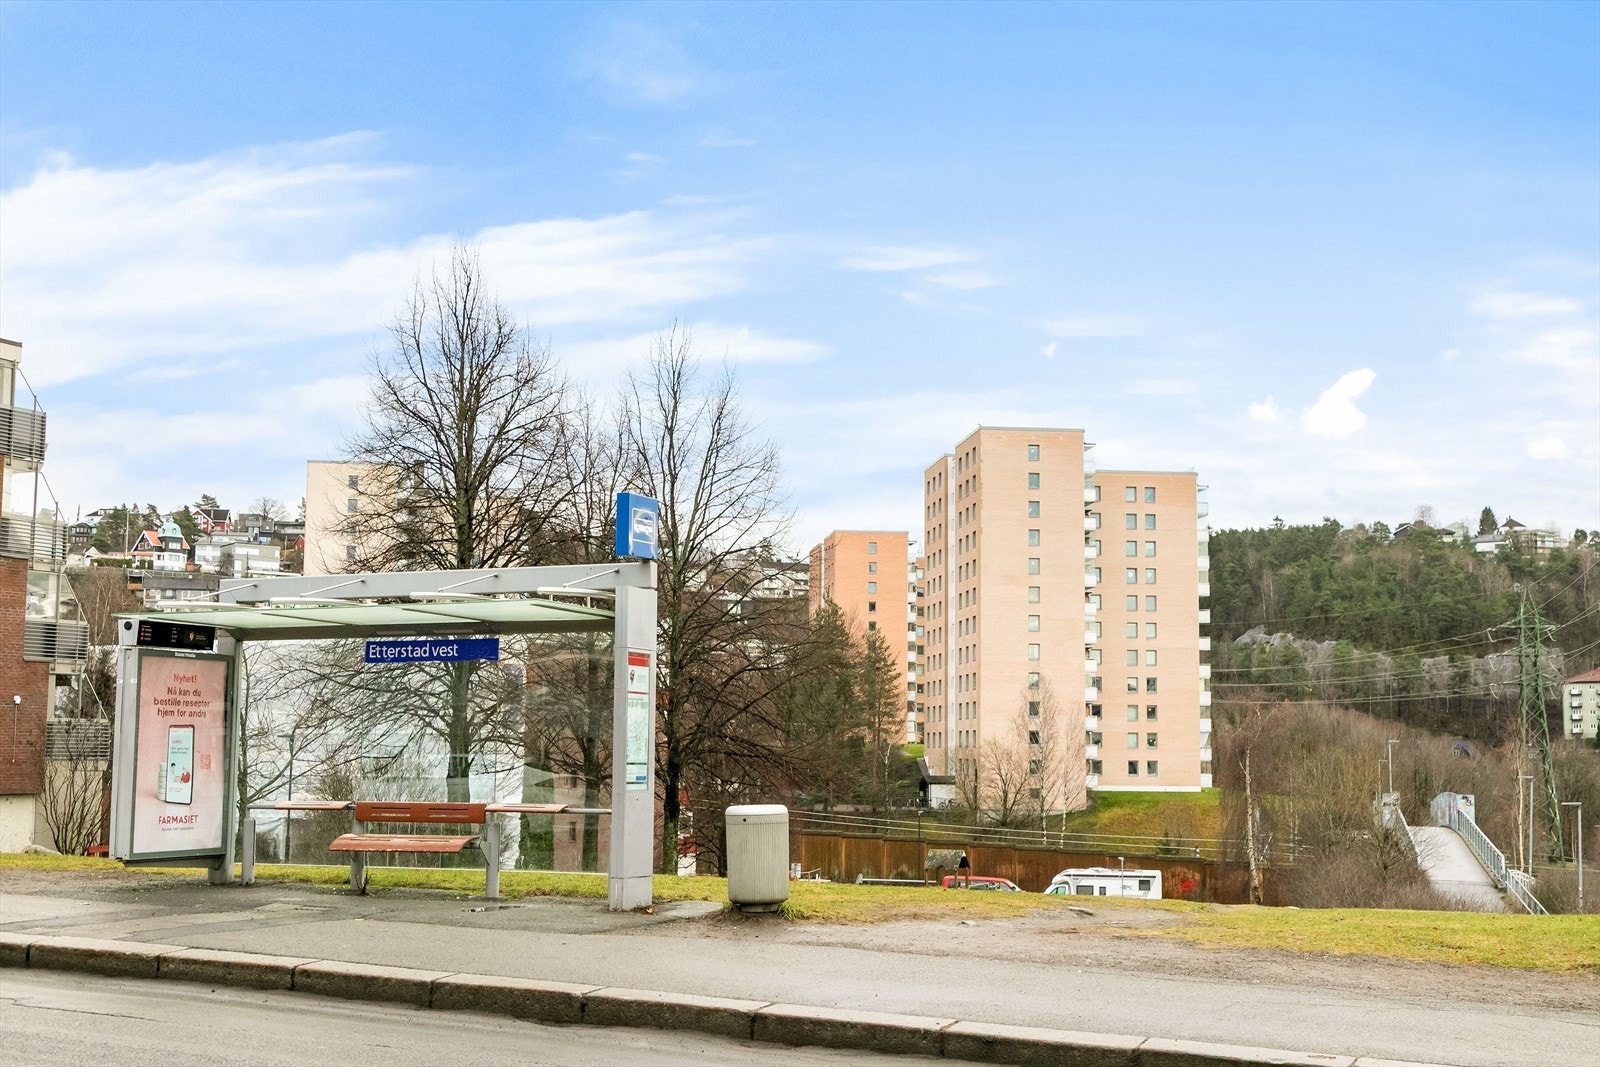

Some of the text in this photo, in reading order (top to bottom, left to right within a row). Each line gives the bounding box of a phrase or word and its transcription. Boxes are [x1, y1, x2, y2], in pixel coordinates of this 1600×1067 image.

[369, 643, 458, 658] Etterstad vest
[173, 674, 197, 684] Nyhet!
[167, 686, 202, 697] Nå kan du
[153, 697, 210, 708] bestille resepter
[157, 707, 207, 718] hjem for andre
[158, 815, 198, 824] FARMASIET
